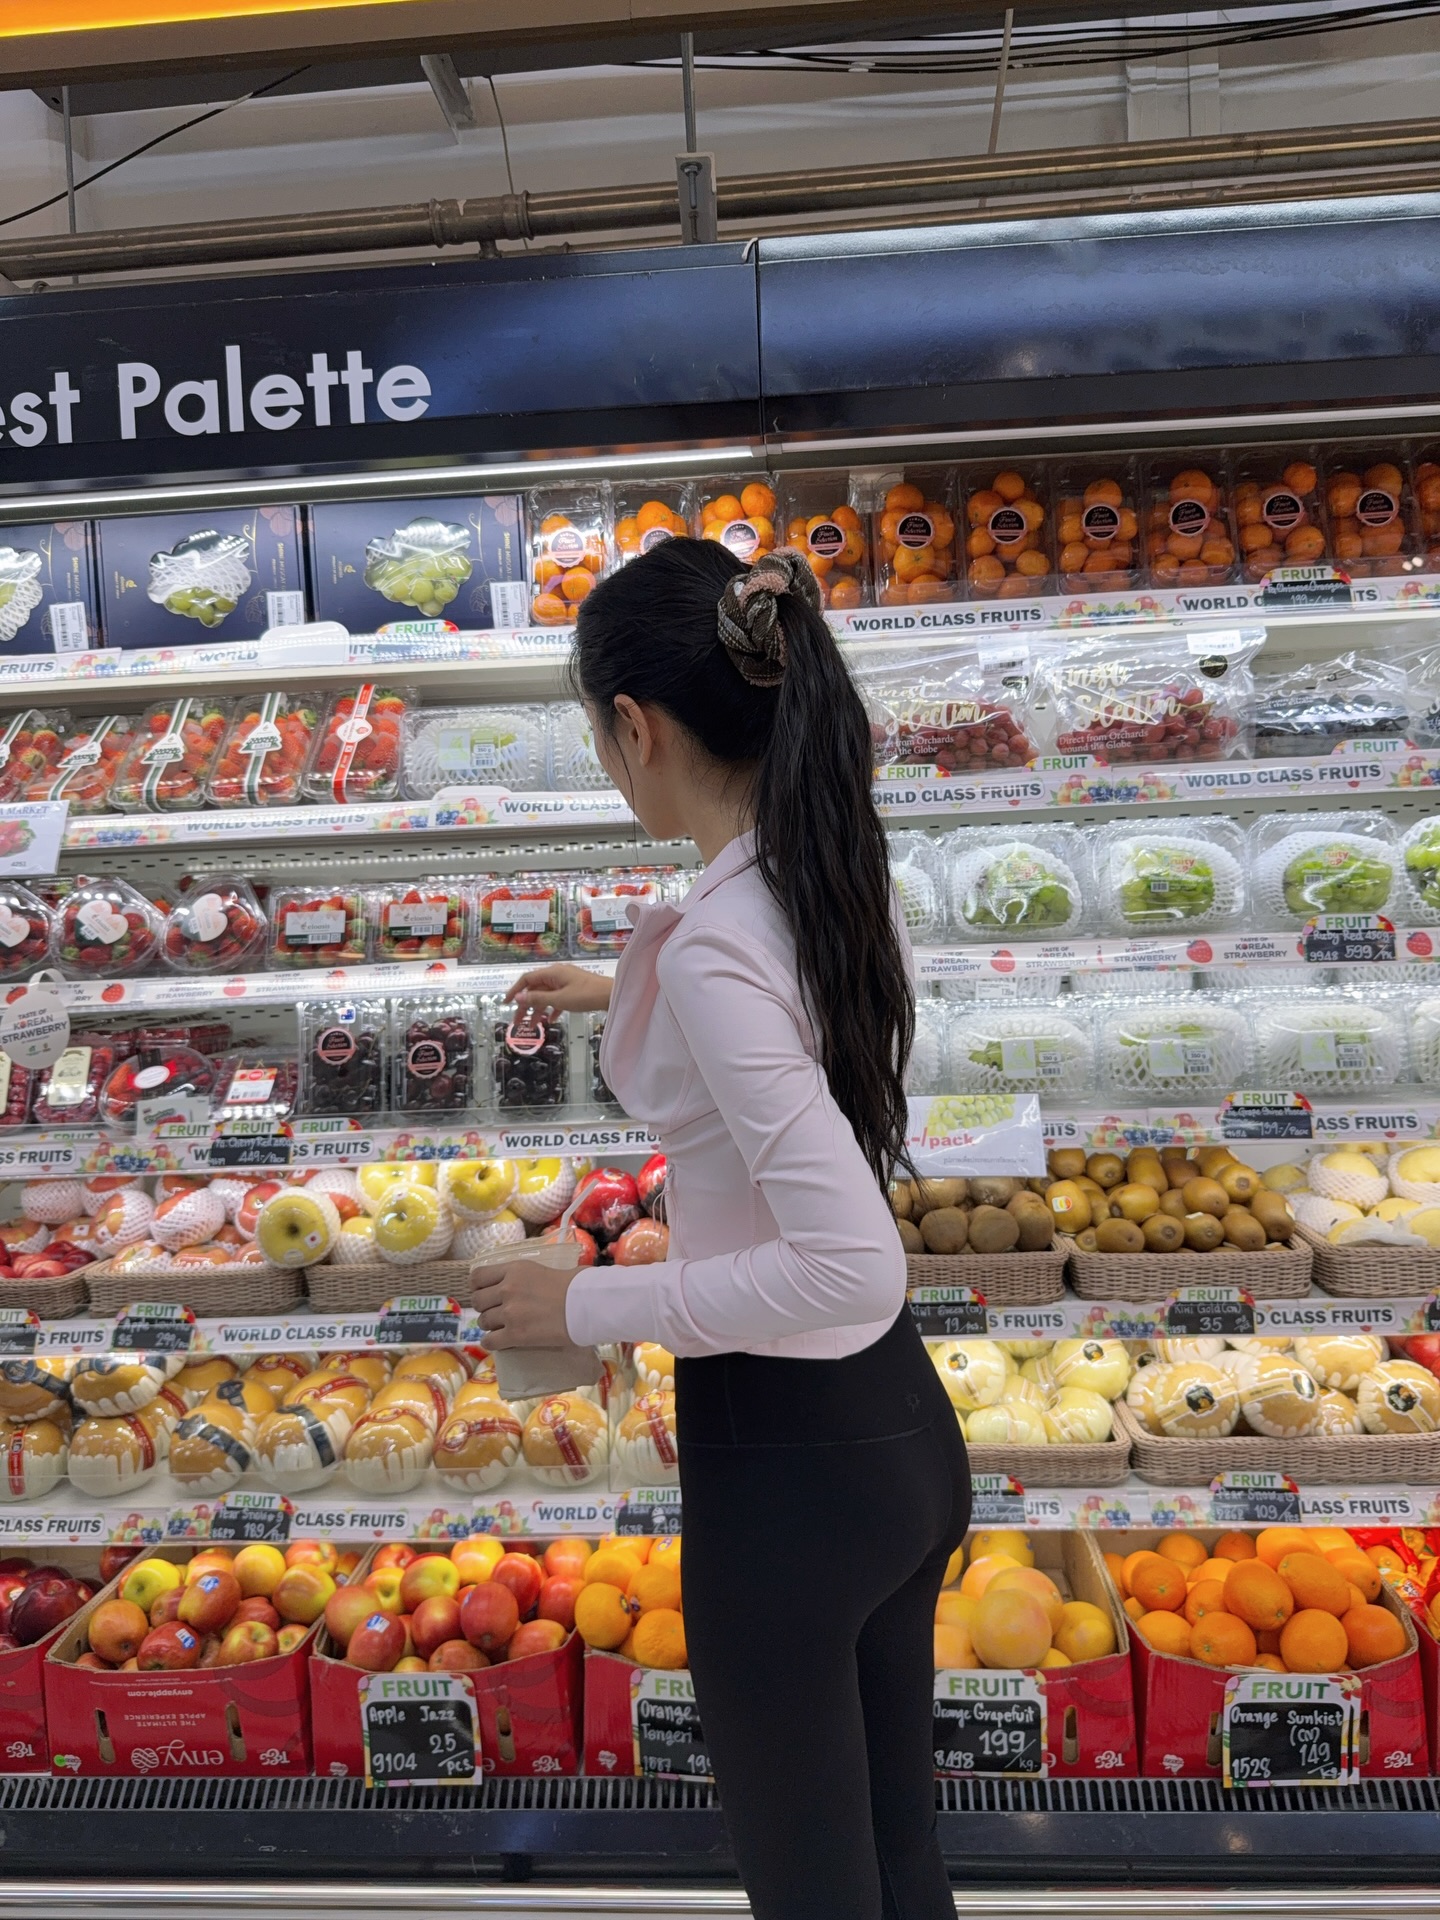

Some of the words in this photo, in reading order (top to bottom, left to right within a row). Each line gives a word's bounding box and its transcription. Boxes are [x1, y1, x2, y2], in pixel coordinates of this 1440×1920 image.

[0, 371, 80, 447] st
[117, 345, 432, 440] Palette
[1281, 568, 1326, 580] FRUIT
[1183, 597, 1248, 611] WORLD
[853, 617, 916, 631] WORLD
[920, 613, 976, 627] CLASS
[980, 609, 1042, 624] FRUITS
[395, 622, 438, 634] FRUIT
[0, 661, 55, 674] FRUITS
[916, 735, 954, 746] Orchards
[1059, 736, 1084, 746] Direct
[1086, 733, 1108, 744] from
[1108, 728, 1149, 741] Orchards
[914, 745, 938, 754] Globe
[1106, 740, 1132, 750] Globe
[1353, 741, 1398, 752] FRUIT
[1043, 756, 1088, 770] FRUIT
[887, 766, 930, 778] FRUIT
[1186, 772, 1251, 788] WORLD
[1257, 768, 1314, 783] CLASS
[1319, 764, 1381, 780] FRUITS
[922, 788, 976, 802] CLASS
[982, 784, 1042, 798] FRUITS
[505, 800, 564, 813] WORLD
[570, 798, 622, 812] CLASS
[308, 812, 366, 826] FRUITS
[1326, 916, 1372, 928] FRUIT
[1235, 942, 1274, 950] KOREAN
[1344, 944, 1372, 958] 599
[1114, 953, 1177, 962] STRAWBERRY
[1224, 950, 1288, 959] STRAWBERRY
[920, 963, 981, 974] STRAWBERRY
[1026, 958, 1088, 968] STRAWBERRY
[156, 990, 214, 1000] STRAWBERRY
[14, 1015, 54, 1030] KOREAN
[18, 1012, 37, 1020] TASTE
[2, 1022, 68, 1044] STRAWBERRY
[1243, 1094, 1288, 1104] FRUIT
[232, 1122, 274, 1134] FRUIT
[301, 1120, 344, 1132] FRUIT
[1316, 1116, 1350, 1130] ASS
[1356, 1114, 1418, 1130] FRUITS
[169, 1124, 210, 1136] FRUIT
[505, 1134, 566, 1148] WORLD
[569, 1132, 620, 1146] CLASS
[314, 1141, 370, 1156] FRUITS
[19, 1150, 72, 1164] FRUITS
[921, 1289, 964, 1301] FRUIT
[1188, 1289, 1232, 1300] FRUIT
[137, 1305, 178, 1316] FRUIT
[400, 1298, 442, 1310] FRUIT
[0, 1311, 22, 1322] UIT
[1004, 1313, 1064, 1328] FRUITS
[1270, 1310, 1326, 1324] CLASS
[1332, 1308, 1393, 1322] FRUITS
[1200, 1316, 1222, 1332] 35
[50, 1330, 104, 1344] FRUITS
[224, 1326, 281, 1342] WORLD
[286, 1325, 337, 1340] CLASS
[1232, 1474, 1276, 1486] FRUIT
[234, 1494, 276, 1507] FRUIT
[638, 1490, 680, 1502] FRUIT
[539, 1506, 597, 1520] WORLD
[1026, 1502, 1060, 1515] UITS
[1302, 1499, 1344, 1514] LASS
[1350, 1499, 1410, 1514] FRUITS
[46, 1518, 101, 1533] FRUITS
[295, 1511, 344, 1526] CLASS
[350, 1513, 406, 1528] FRUITS
[128, 1689, 194, 1698] envyapple.com
[382, 1680, 452, 1698] FRUIT
[656, 1678, 694, 1697] FRU
[950, 1677, 1024, 1696] FRUIT
[1252, 1682, 1330, 1700] FRUIT
[370, 1706, 406, 1724] Apple
[420, 1706, 456, 1722] Jazz
[641, 1702, 692, 1722] Orange
[933, 1701, 971, 1728] Orange
[1230, 1706, 1278, 1729] Orange
[1287, 1710, 1343, 1726] Sunkist
[430, 1734, 456, 1754] 25
[979, 1729, 1026, 1756] 199
[156, 1739, 224, 1766] envy
[1300, 1744, 1330, 1766] 149
[372, 1752, 418, 1774] 9104
[1232, 1758, 1272, 1779] 1528
